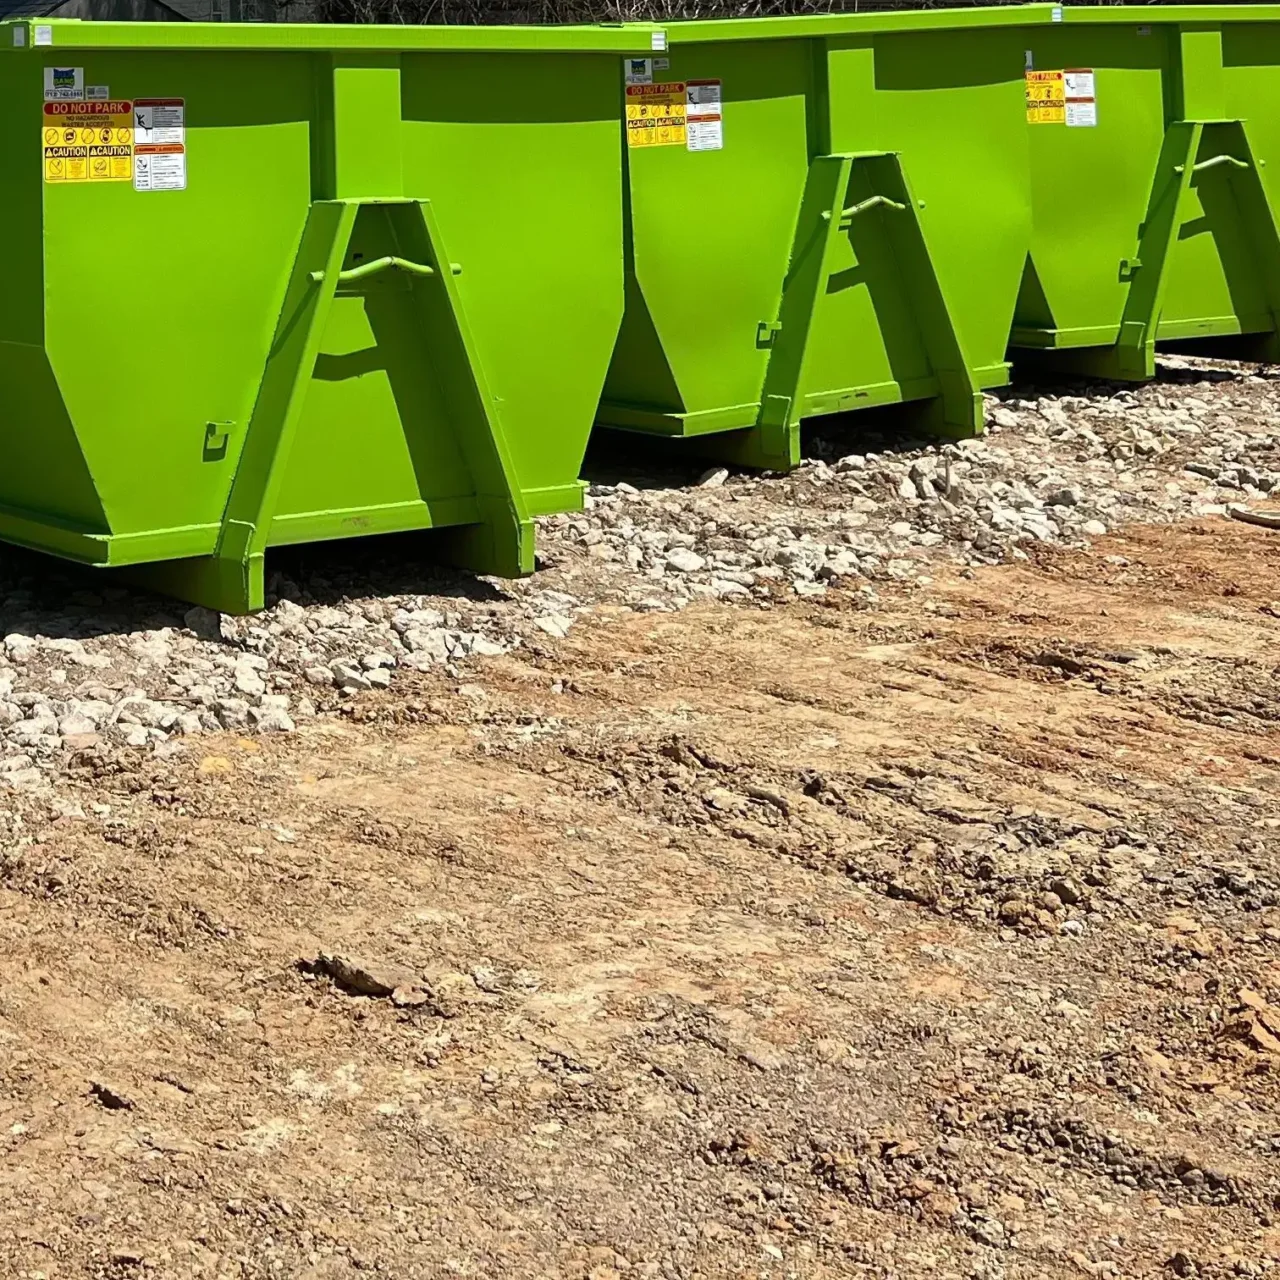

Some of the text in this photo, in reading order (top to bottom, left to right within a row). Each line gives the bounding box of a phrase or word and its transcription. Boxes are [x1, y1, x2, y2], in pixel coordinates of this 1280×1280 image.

[53, 102, 125, 114] DO NOT PARK
[52, 147, 87, 157] CAUTION
[97, 146, 131, 156] CAUTION
